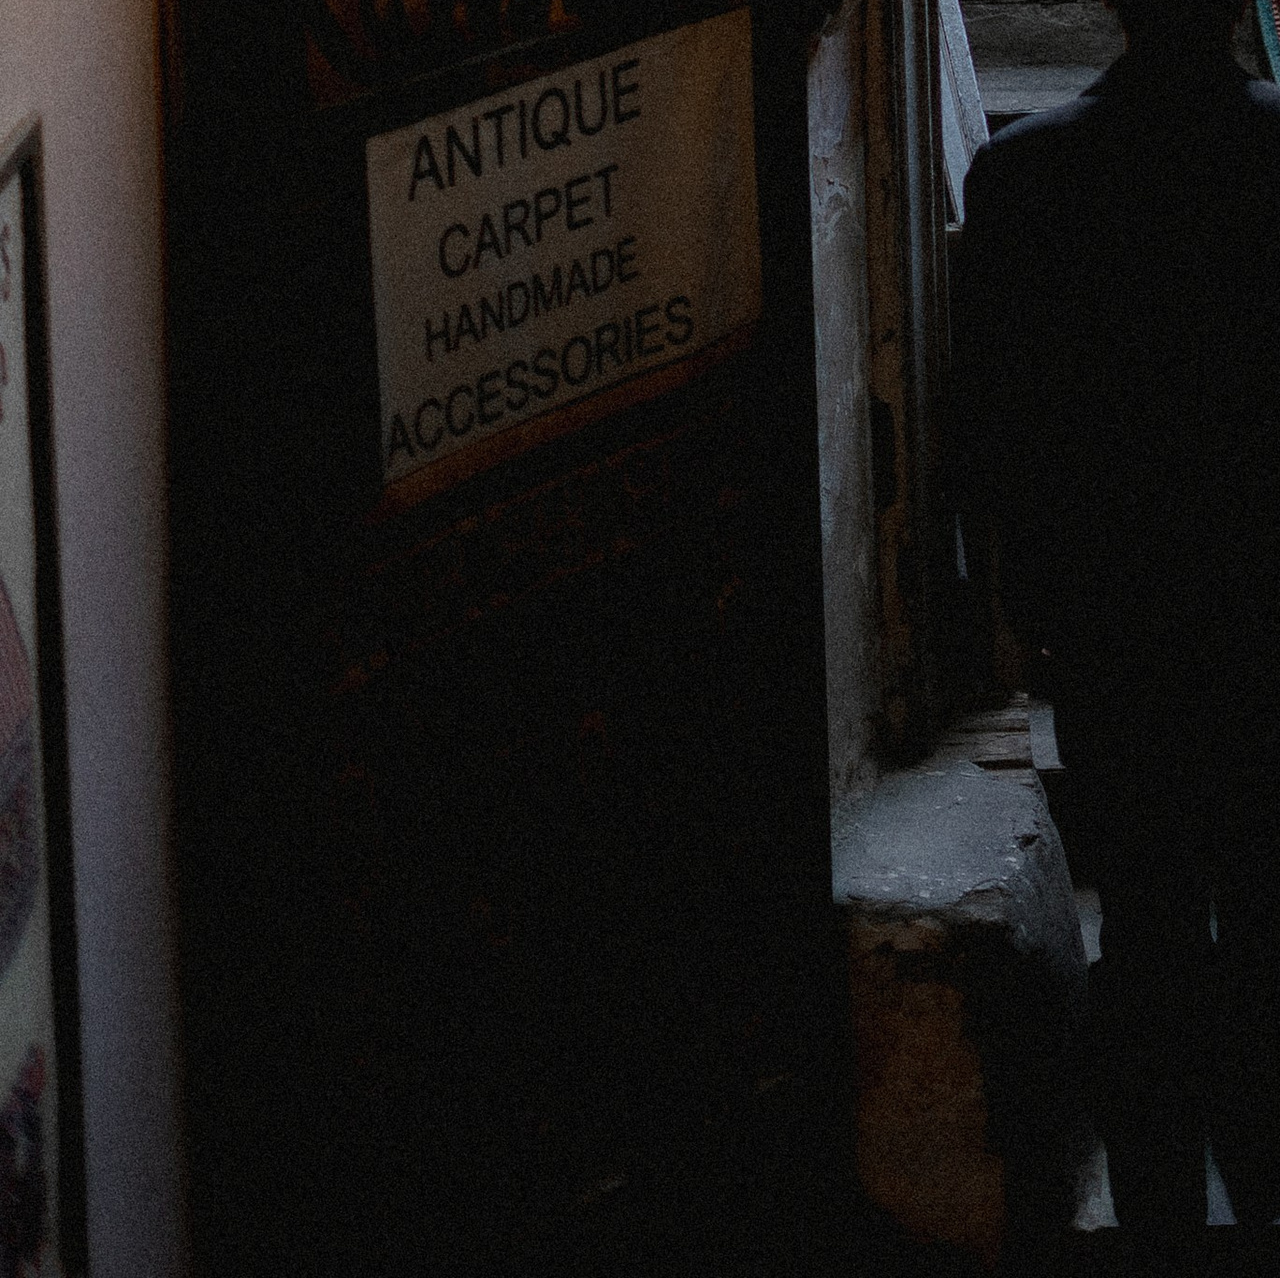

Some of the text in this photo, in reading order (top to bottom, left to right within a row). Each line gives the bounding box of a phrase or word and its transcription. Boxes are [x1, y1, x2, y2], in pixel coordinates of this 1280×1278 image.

[407, 58, 643, 202] ANTIQUE
[438, 163, 620, 279] CARPET
[423, 235, 640, 362] HANDMADE
[387, 295, 695, 460] ACCESSORIES
